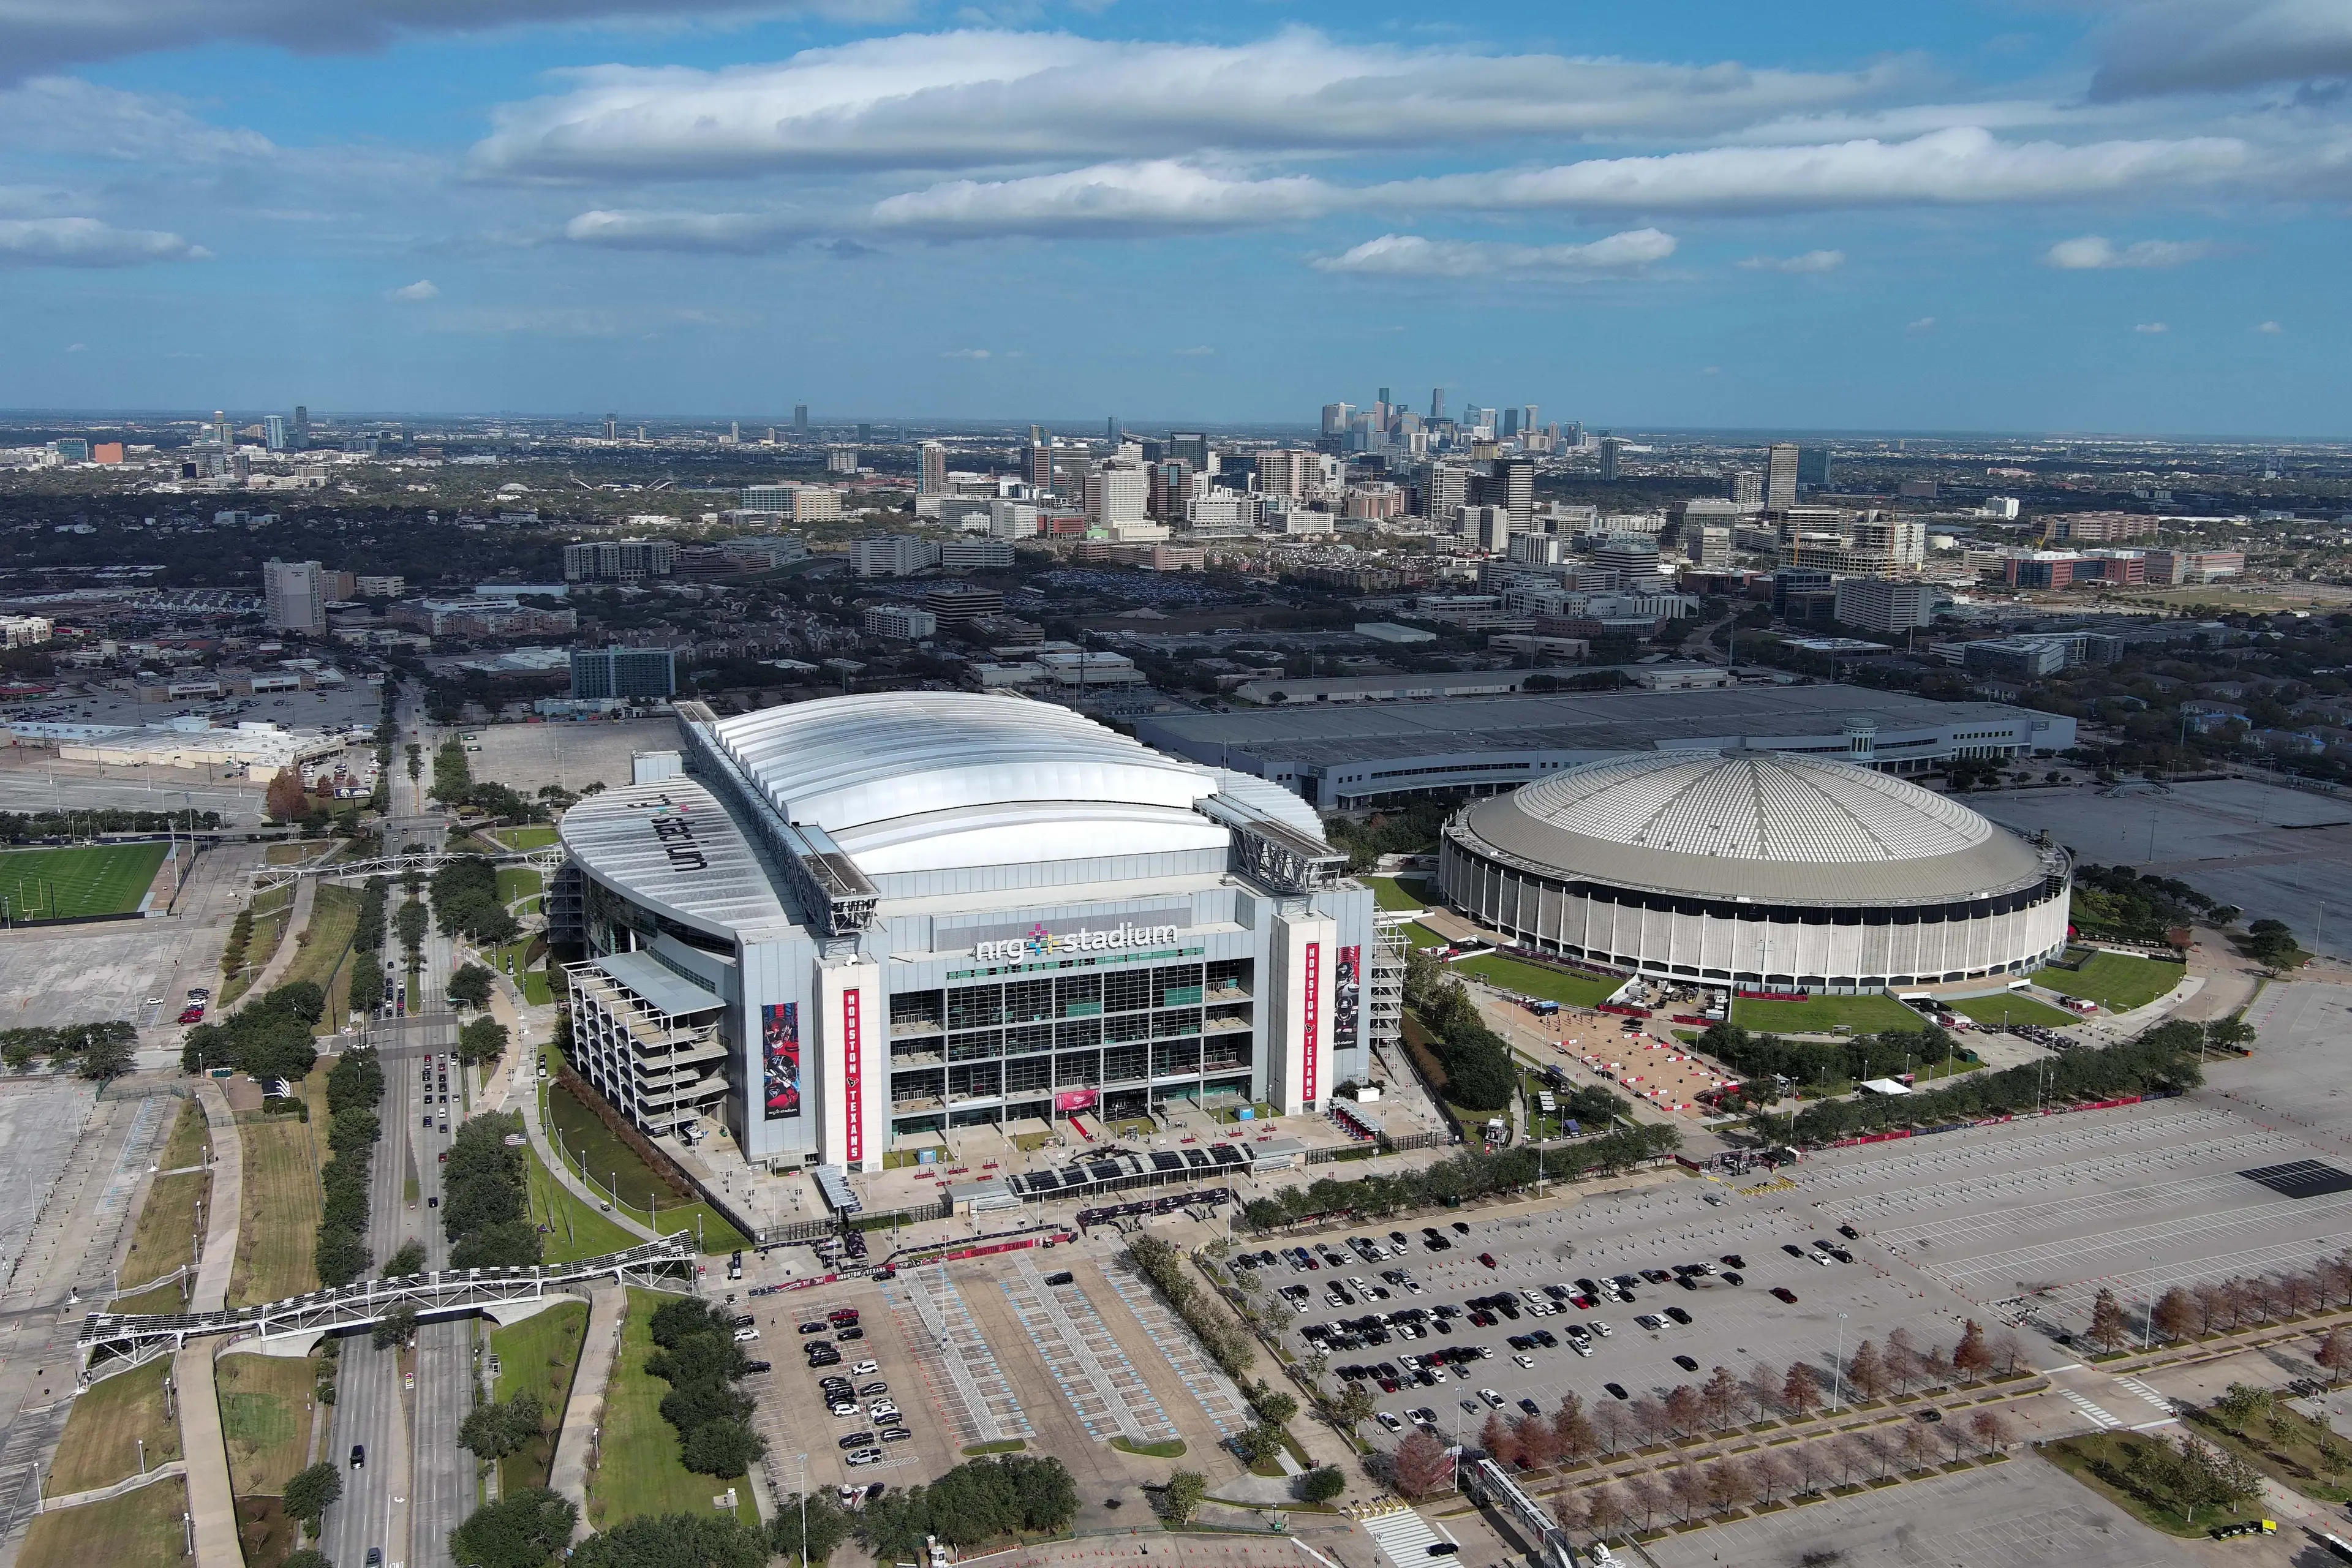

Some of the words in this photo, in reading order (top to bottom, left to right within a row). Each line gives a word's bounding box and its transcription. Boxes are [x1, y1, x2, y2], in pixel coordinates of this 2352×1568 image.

[976, 938, 1025, 965] nrg
[1063, 921, 1178, 952] stadium
[848, 994, 857, 1074] HOUSTON
[971, 1247, 1000, 1257] HOUSTON
[1004, 1242, 1027, 1251] TEXANS
[837, 1271, 861, 1281] HOUSTON
